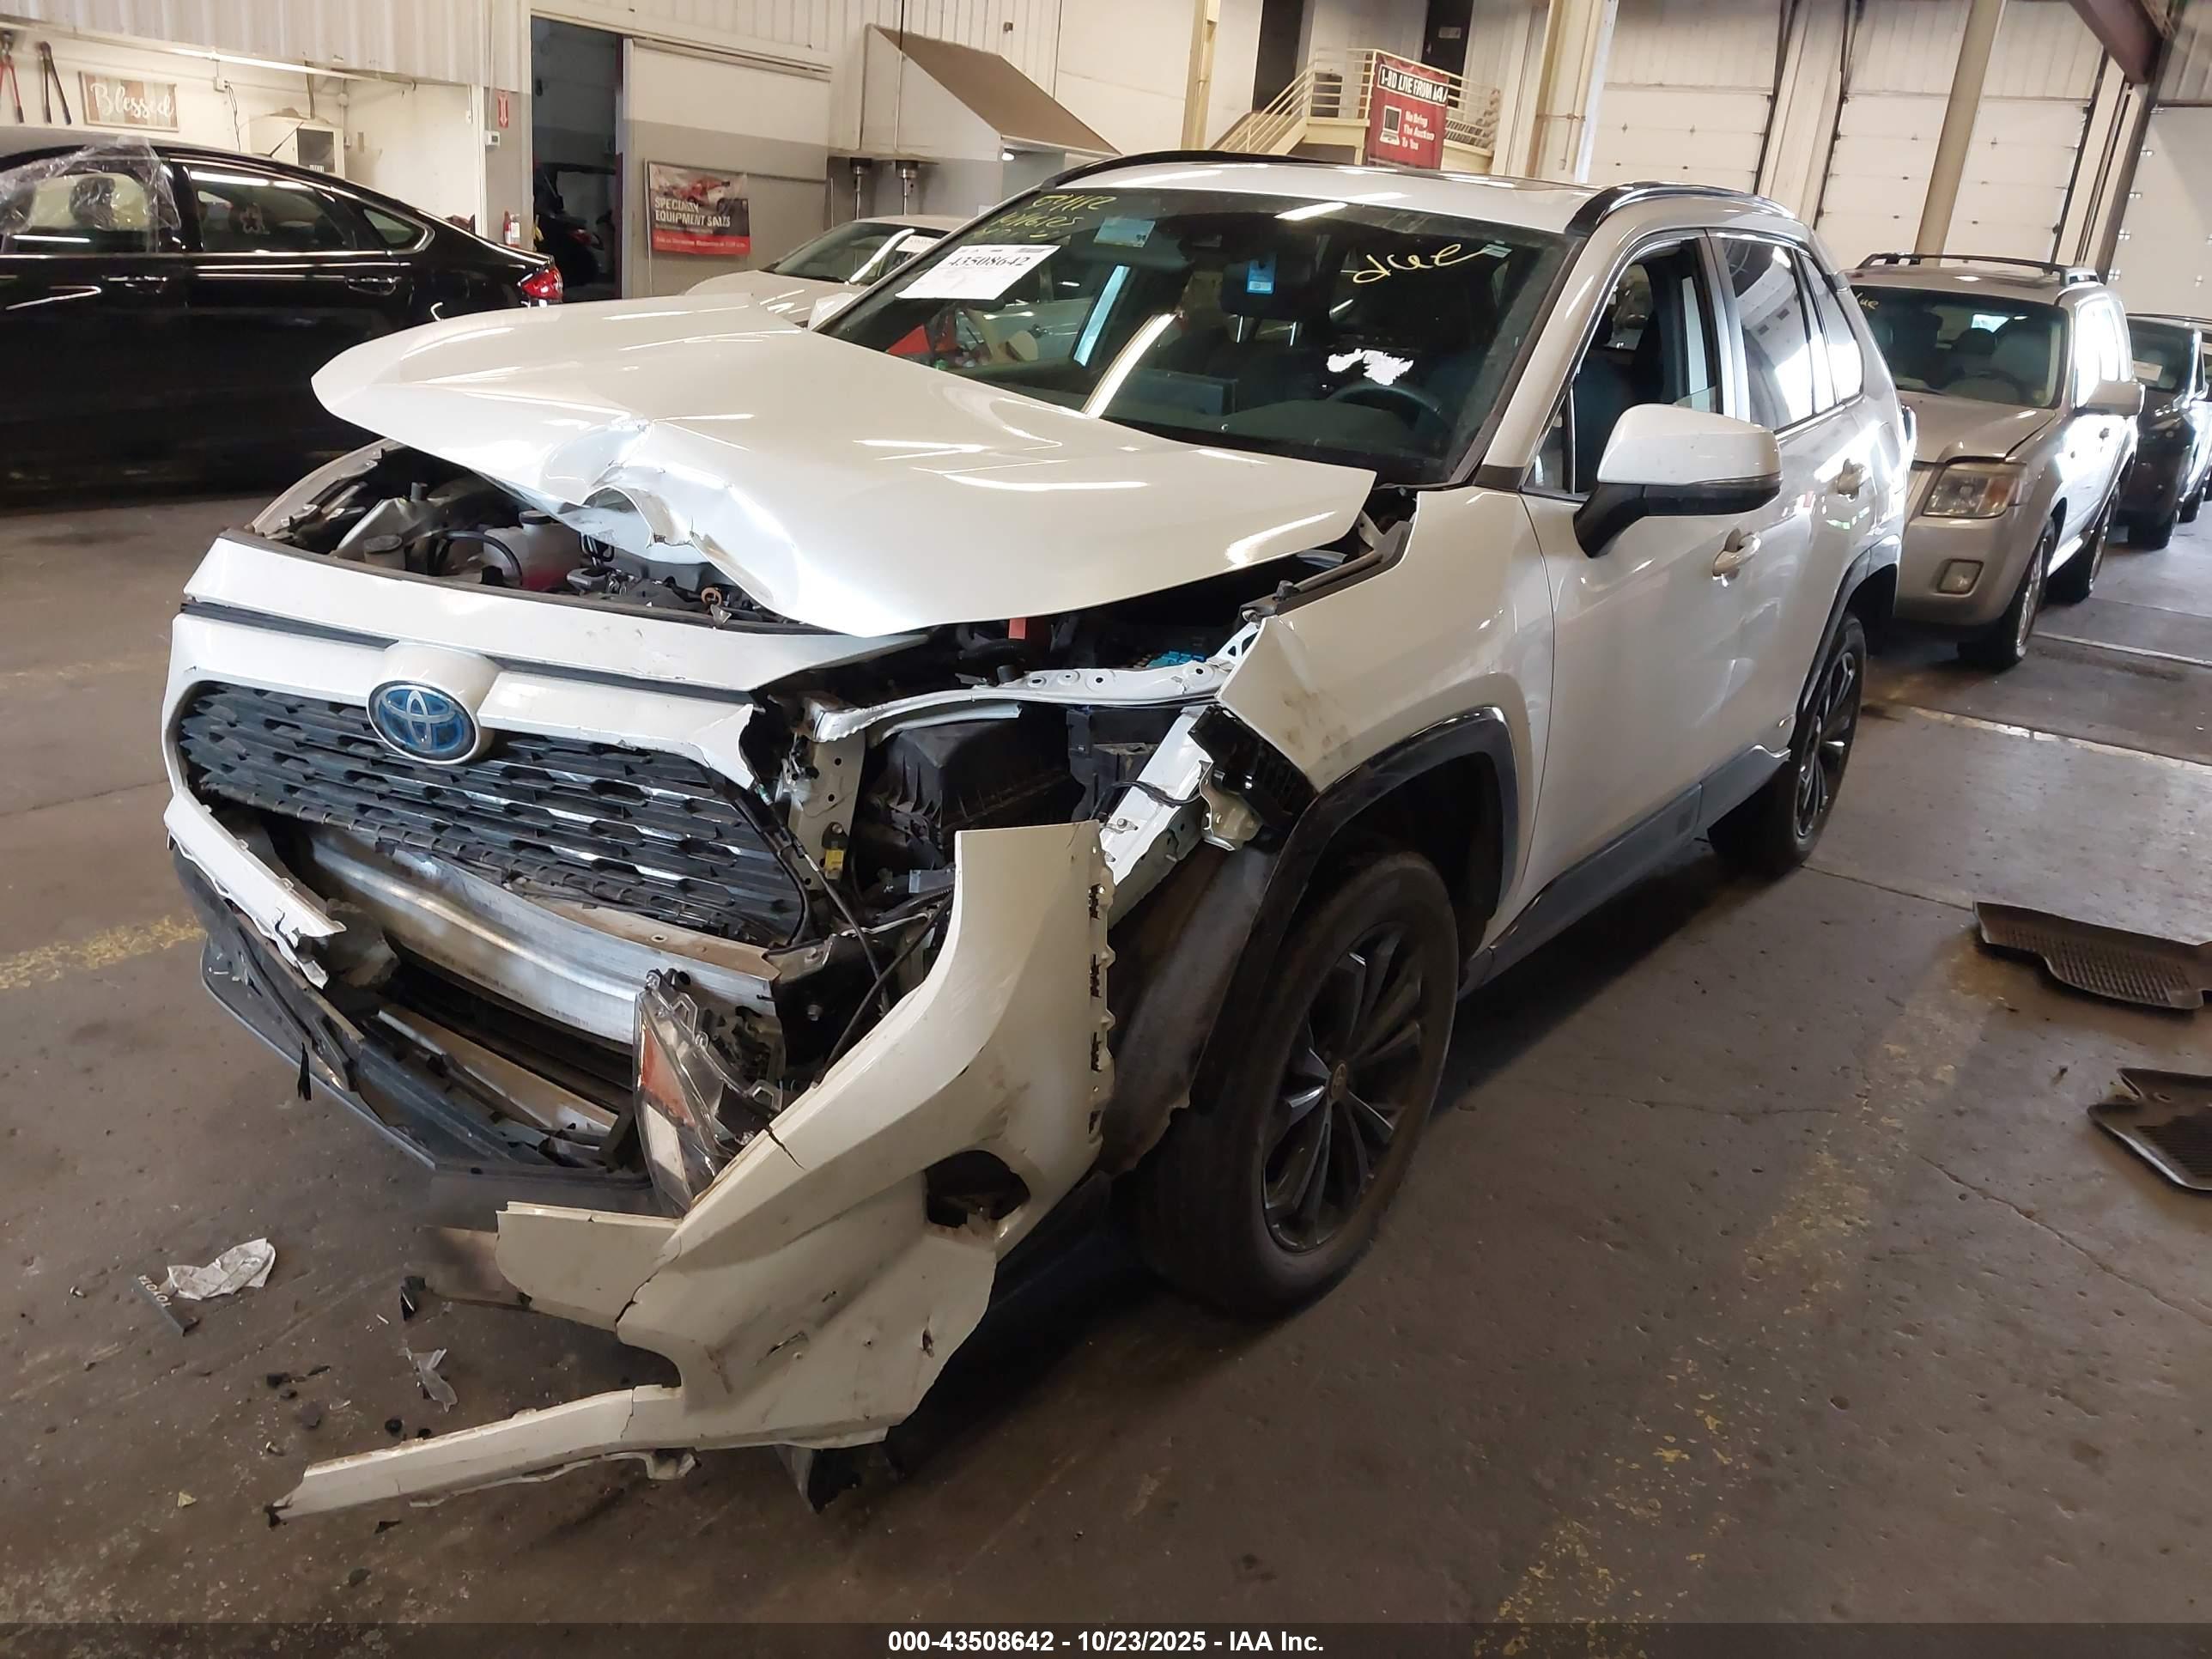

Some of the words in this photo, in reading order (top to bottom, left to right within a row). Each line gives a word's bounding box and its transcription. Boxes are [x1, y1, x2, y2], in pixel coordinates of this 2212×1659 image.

[1398, 75, 1413, 94] LIVE
[1413, 79, 1432, 99] FROM
[89, 82, 174, 118] Blessed
[654, 197, 699, 213] SPECIALTY
[655, 210, 705, 226] EQUIPMENT
[707, 216, 731, 228] SALES
[948, 255, 1031, 267] 43508642
